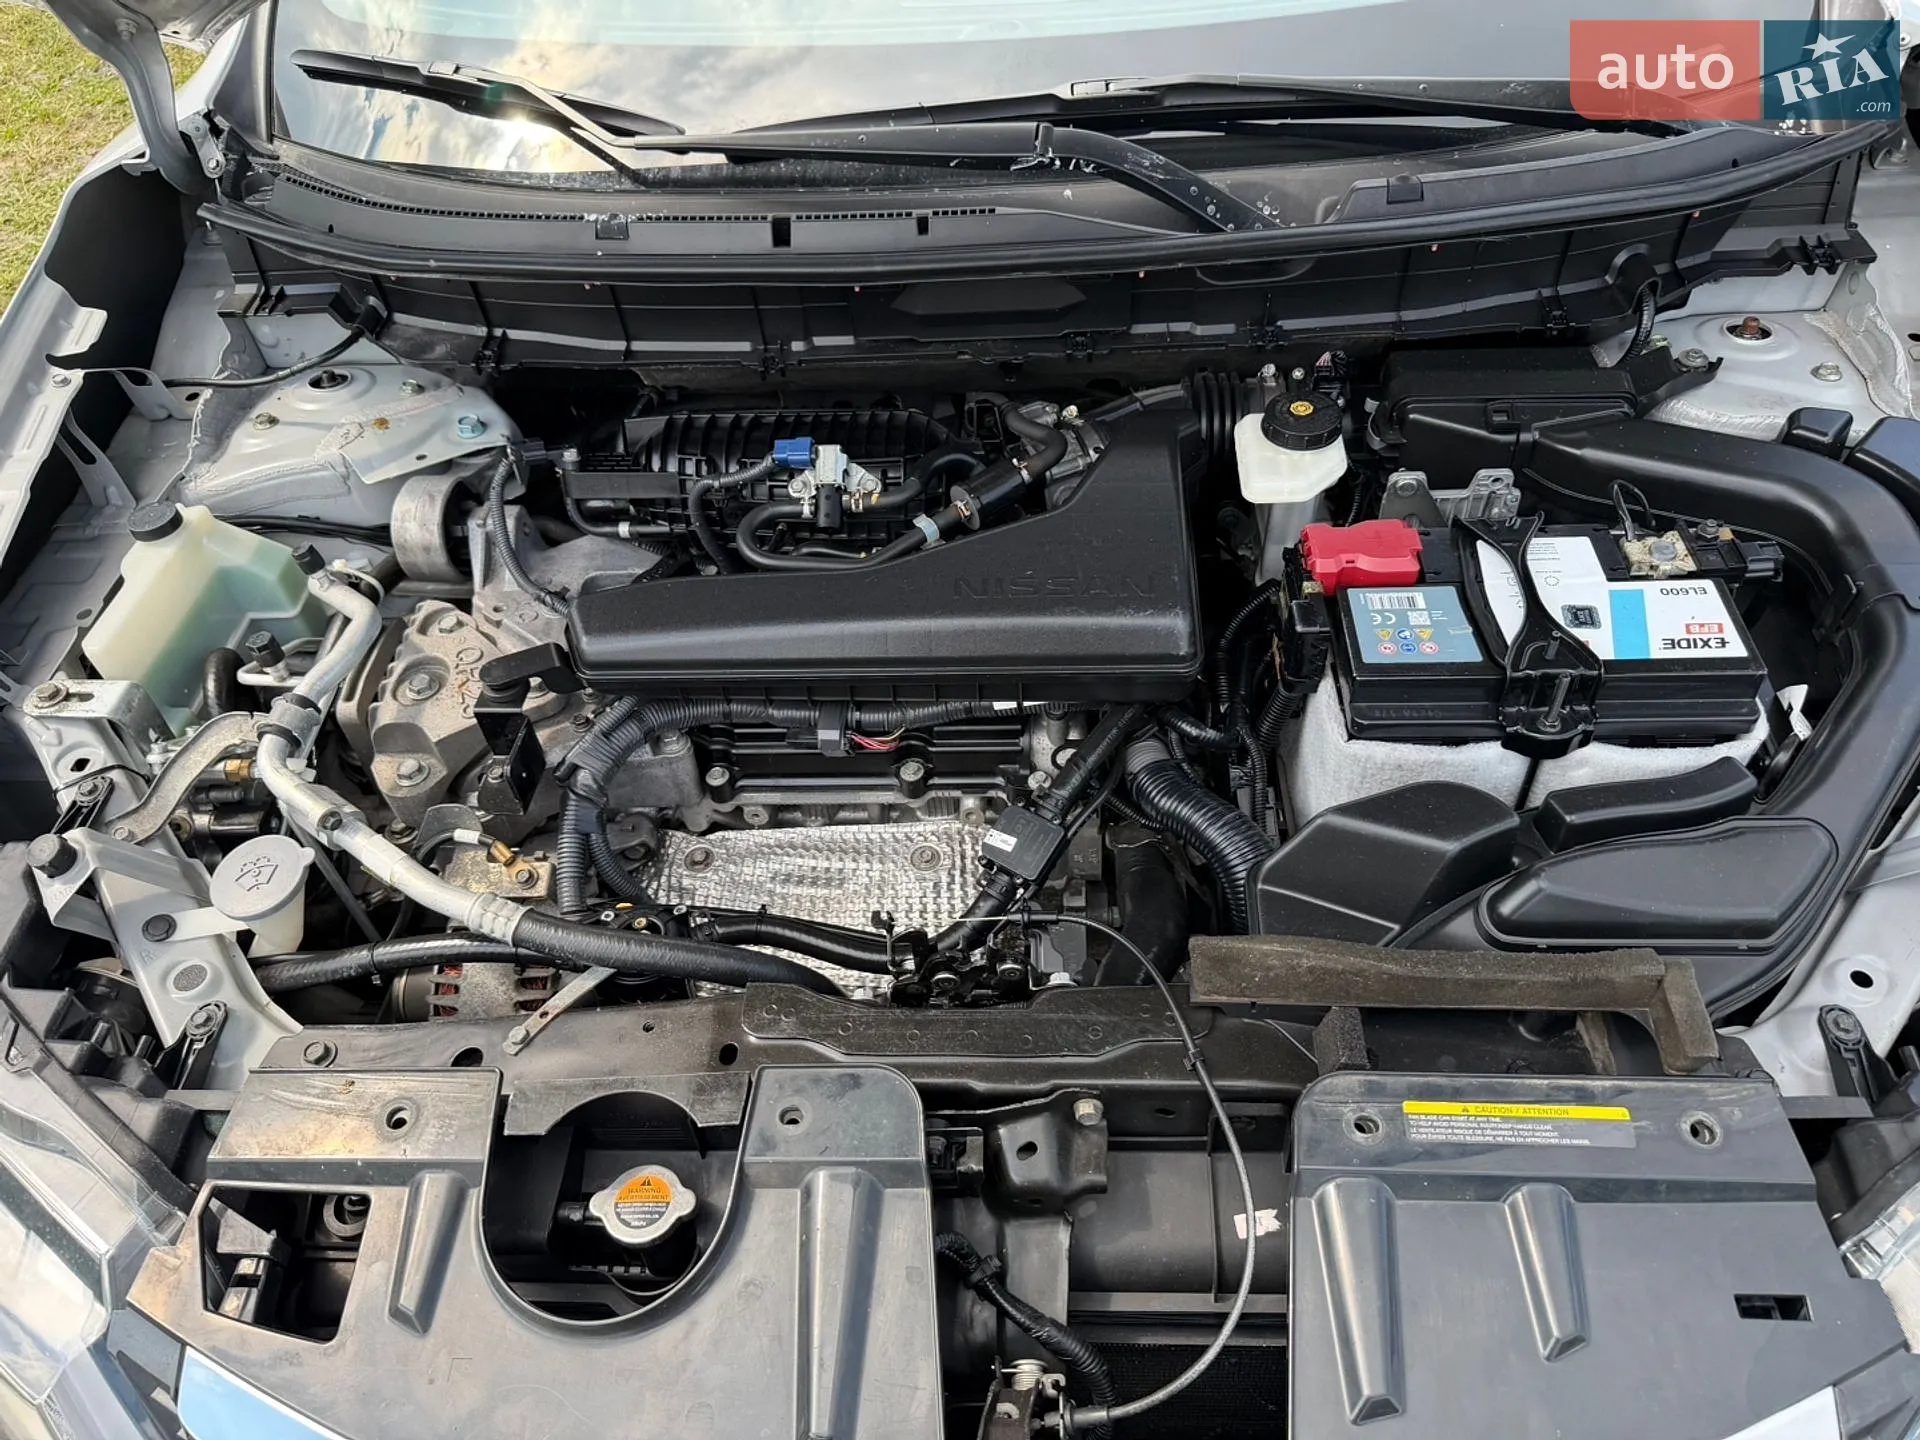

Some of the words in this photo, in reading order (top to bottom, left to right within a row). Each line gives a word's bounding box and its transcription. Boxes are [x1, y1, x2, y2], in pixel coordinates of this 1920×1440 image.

[953, 576, 1156, 599] NISSAN
[1660, 587, 1708, 596] EL600
[1688, 623, 1719, 633] EFB
[1661, 637, 1730, 650] EXIDE
[1475, 1105, 1513, 1115] CAUTION
[1521, 1107, 1569, 1116] ATTENTION
